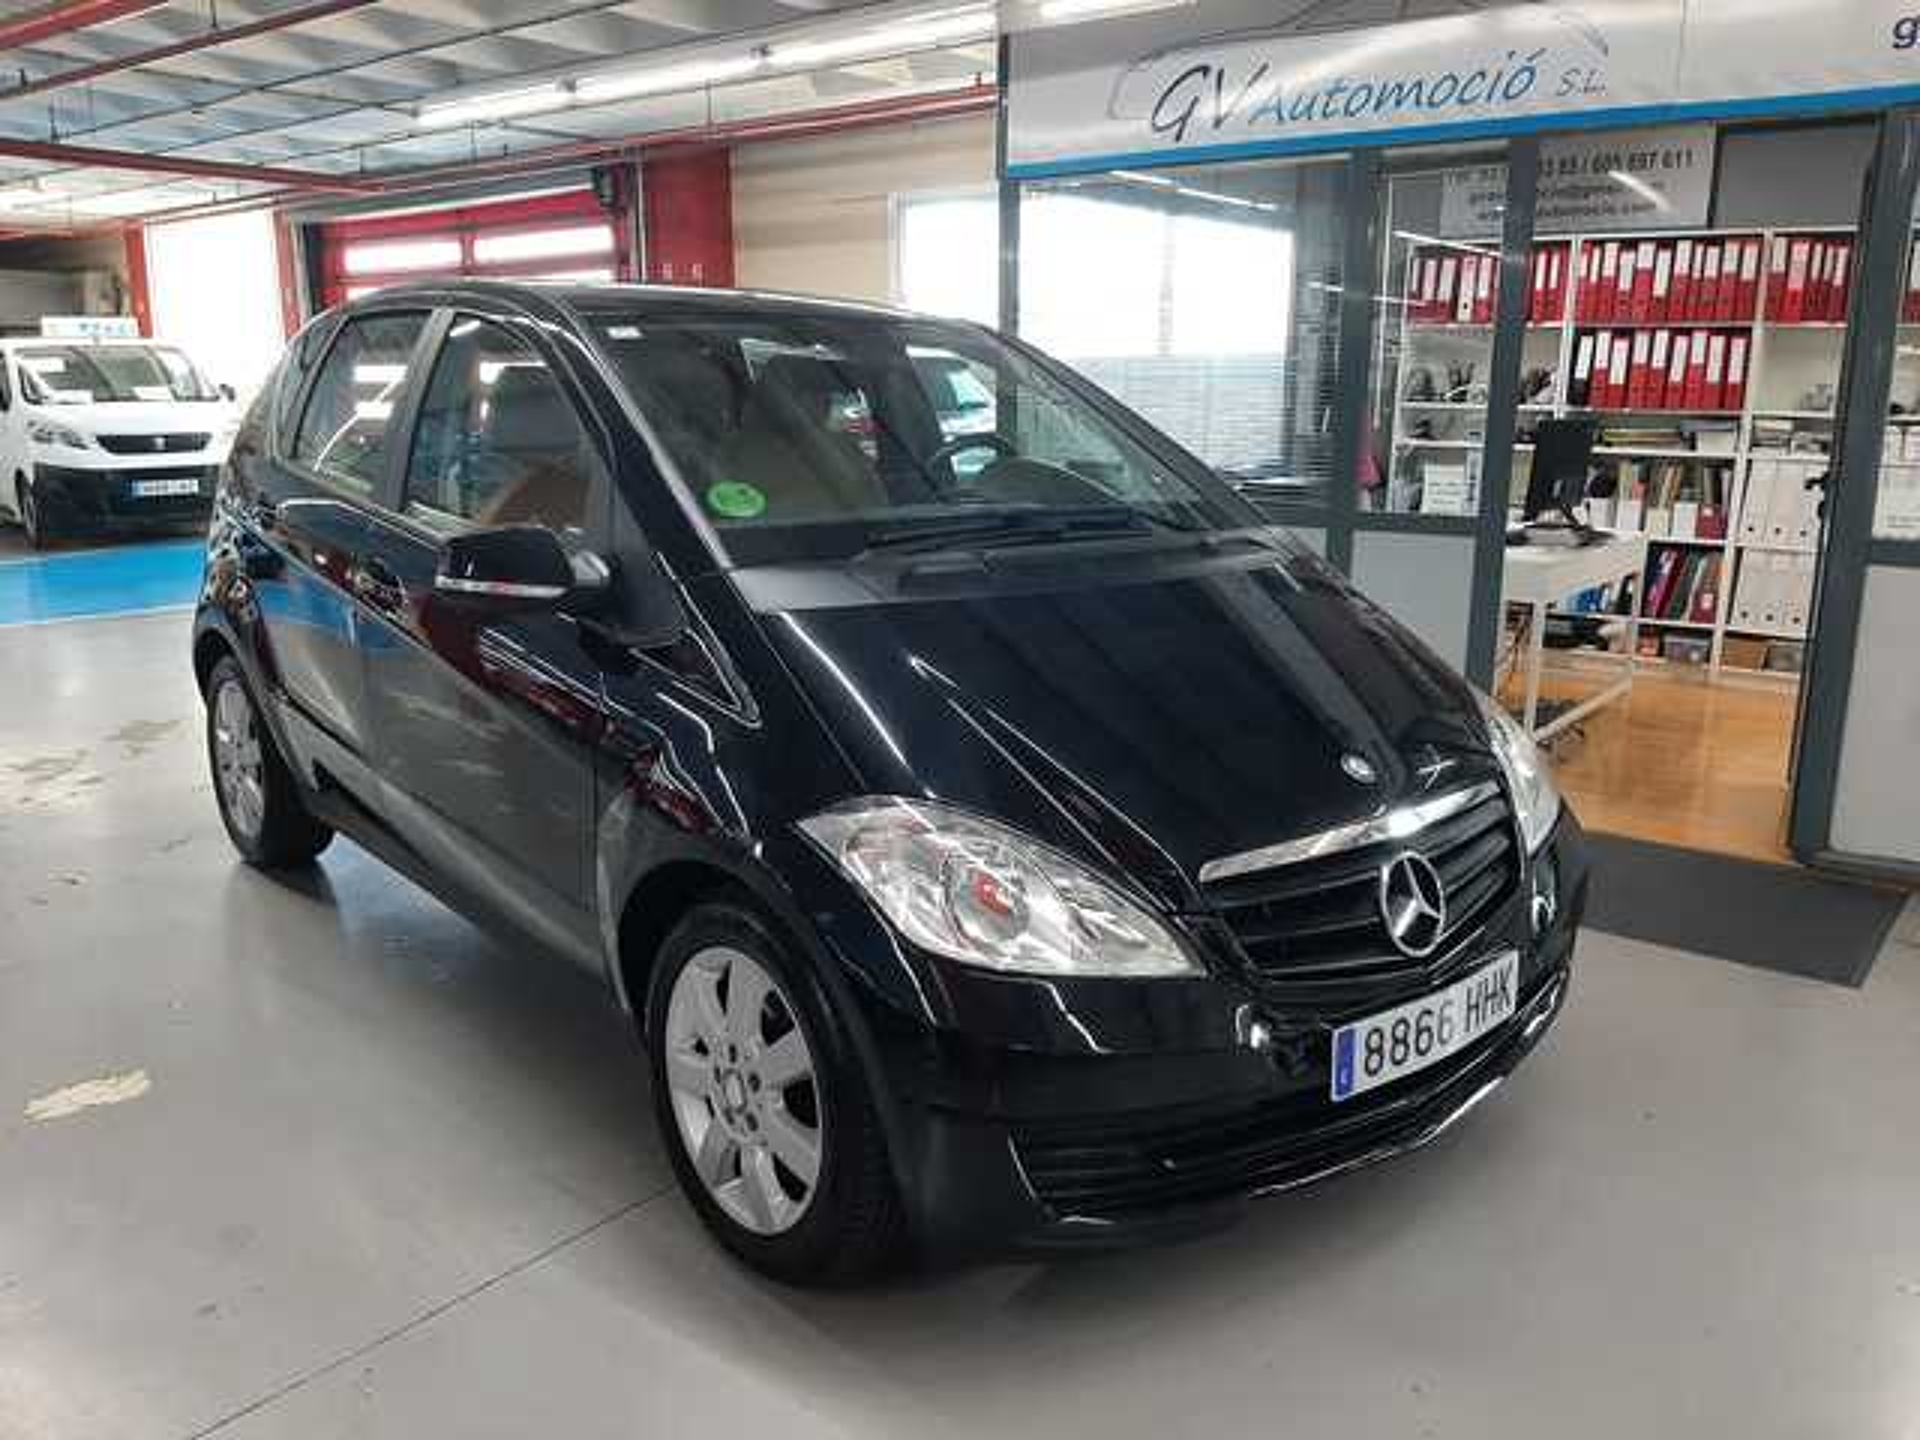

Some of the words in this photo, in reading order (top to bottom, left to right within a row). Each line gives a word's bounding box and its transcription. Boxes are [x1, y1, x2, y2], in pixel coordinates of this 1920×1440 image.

[1152, 63, 1269, 142] GV
[1248, 48, 1546, 125] Automoció
[1364, 999, 1454, 1078] 8866
[1466, 961, 1513, 1034] HHK
